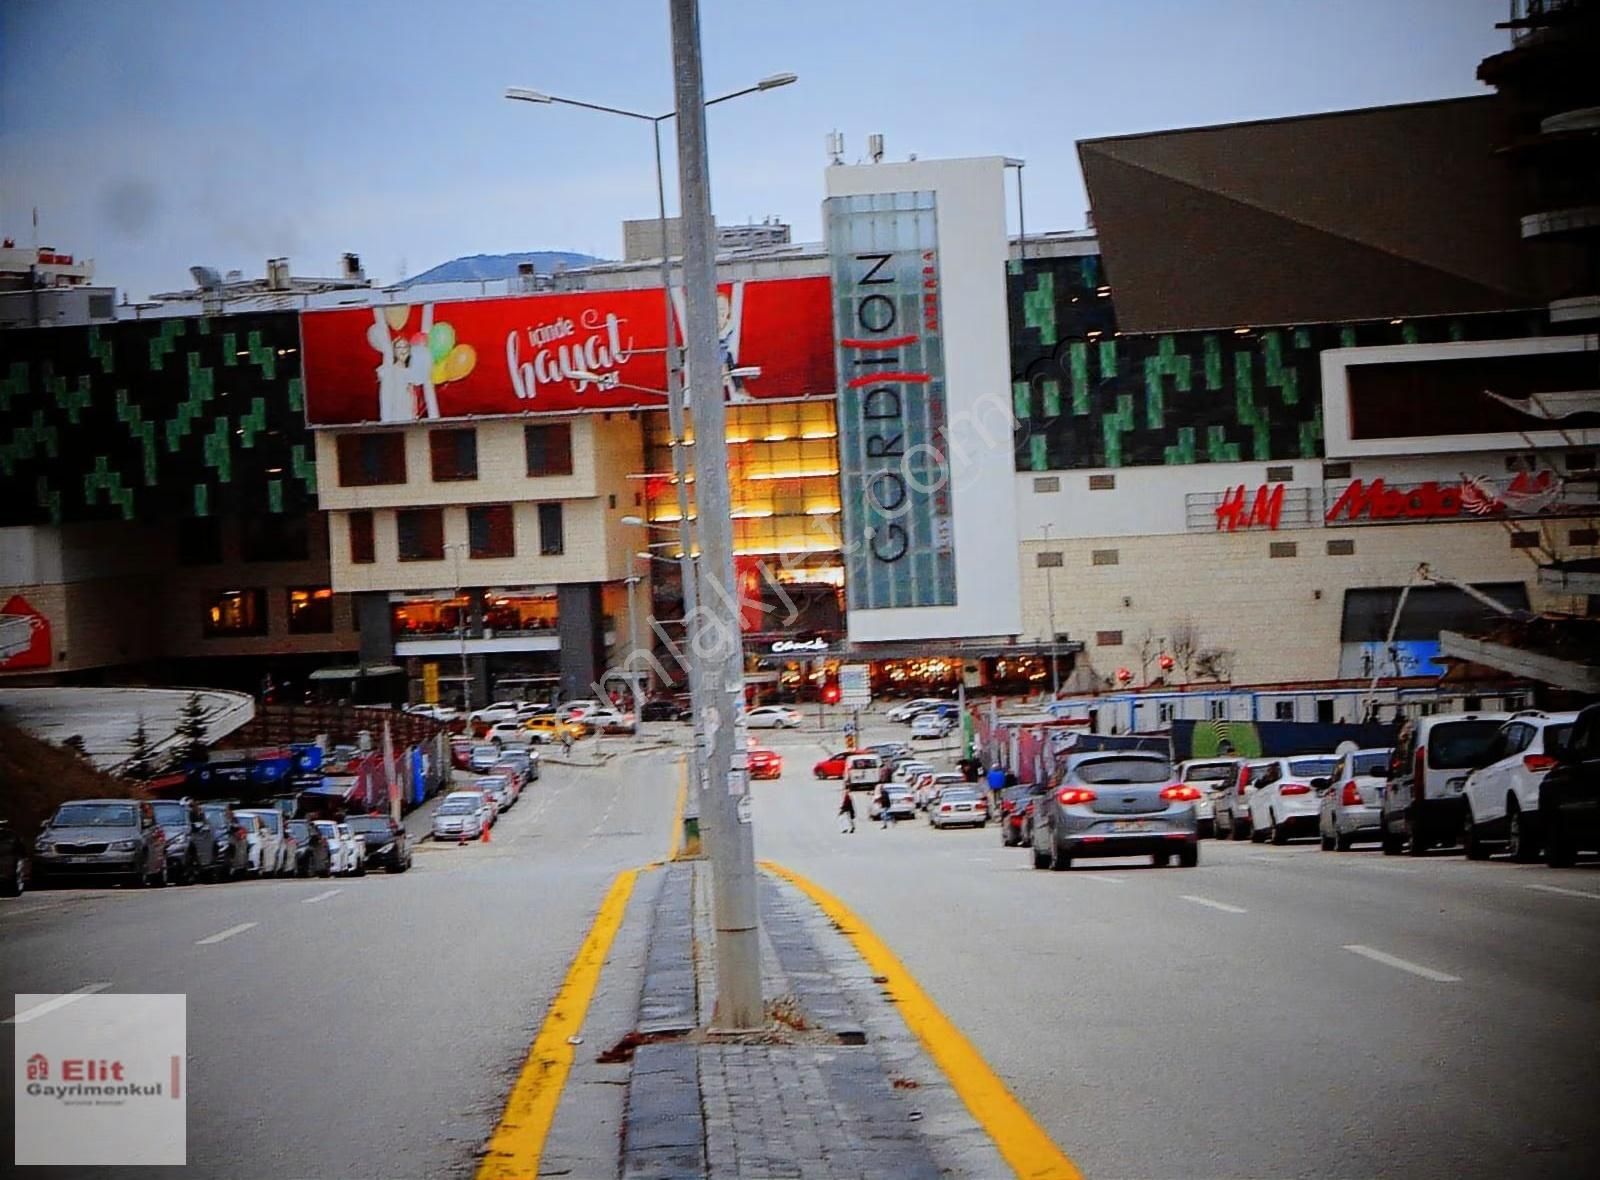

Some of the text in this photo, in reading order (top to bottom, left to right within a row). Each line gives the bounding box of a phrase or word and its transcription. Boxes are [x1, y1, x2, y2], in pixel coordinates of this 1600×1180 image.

[506, 309, 633, 399] hayat
[854, 253, 909, 564] GORDION
[1215, 483, 1285, 532] H&M
